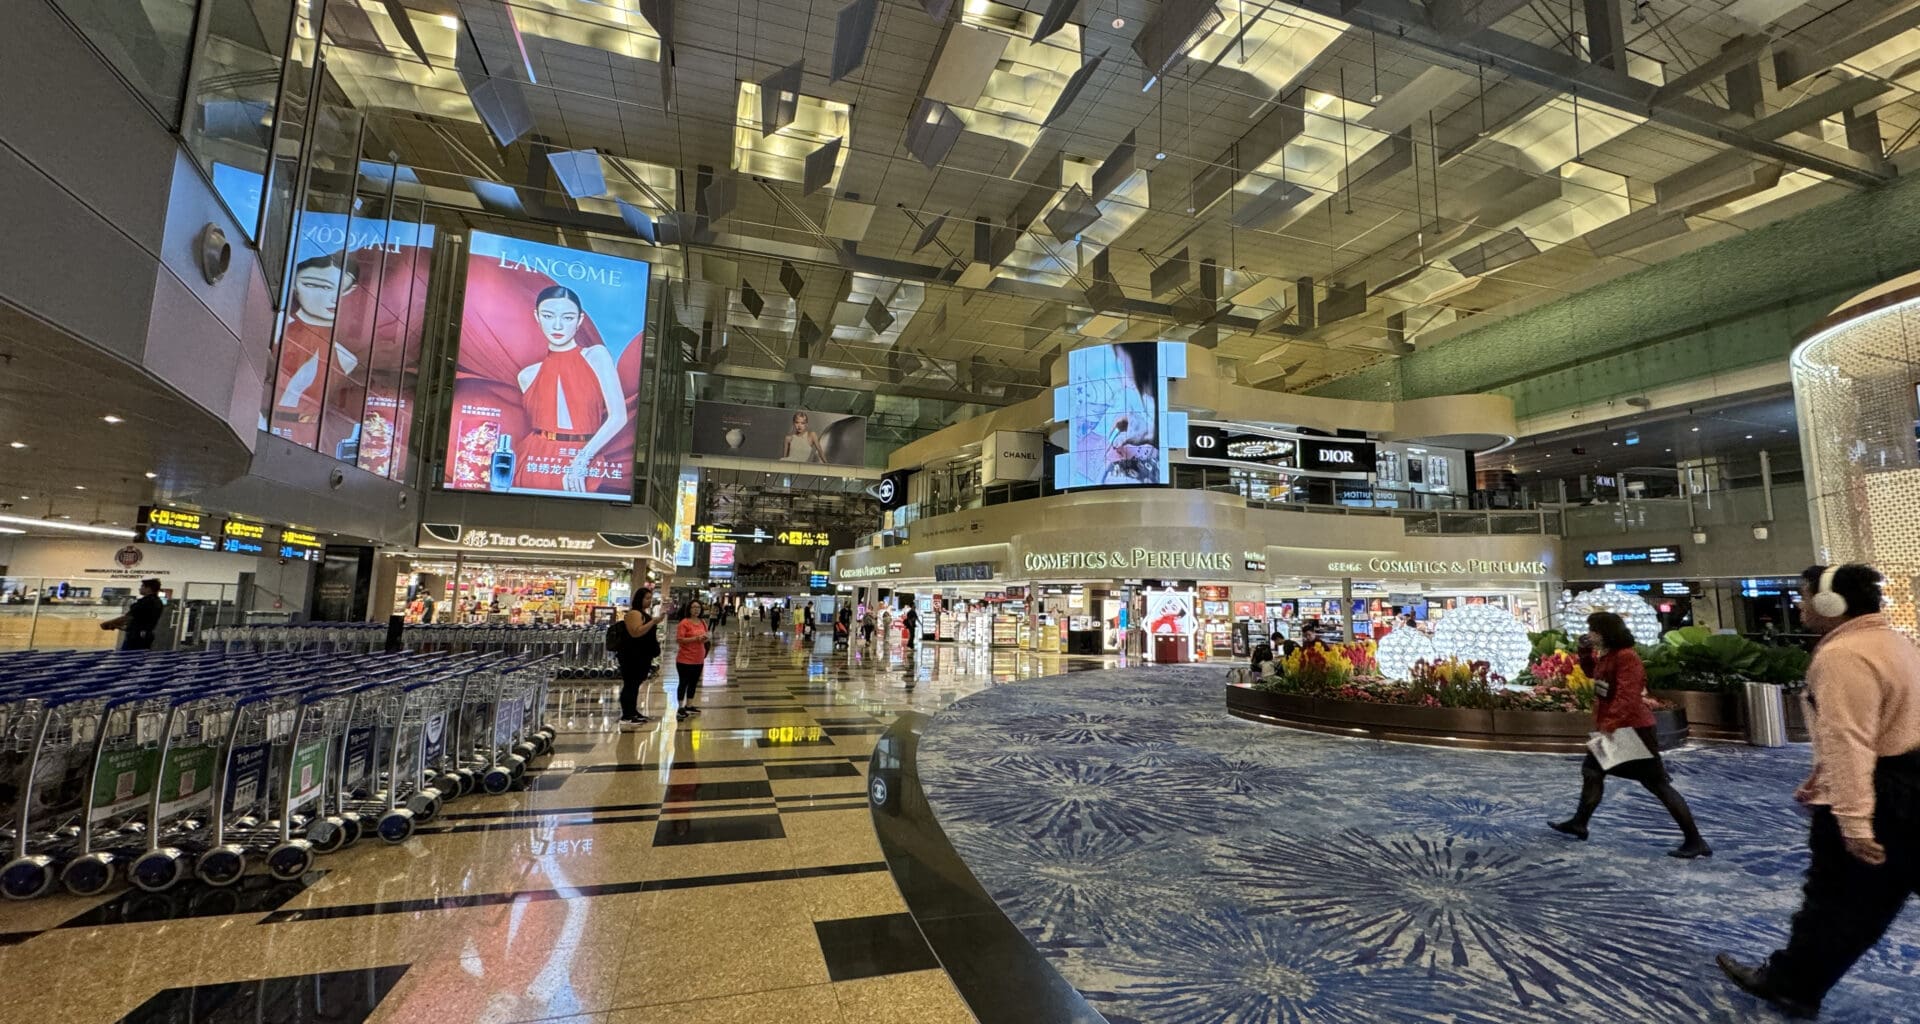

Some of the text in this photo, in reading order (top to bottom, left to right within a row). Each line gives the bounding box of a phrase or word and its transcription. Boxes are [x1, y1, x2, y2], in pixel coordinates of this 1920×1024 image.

[498, 250, 623, 287] LANCÔME
[527, 455, 563, 464] HAPPY
[1003, 451, 1037, 460] CHANEL
[1318, 448, 1354, 463] DIOR
[489, 533, 516, 545] THE
[517, 534, 557, 548] COCOA
[1024, 552, 1106, 572] COSMETICS
[1109, 552, 1129, 568] &
[1131, 547, 1232, 570] PERFUMES
[1368, 557, 1448, 574] COSMETICS
[1450, 561, 1466, 574] &
[1467, 558, 1547, 575] PERFUMES
